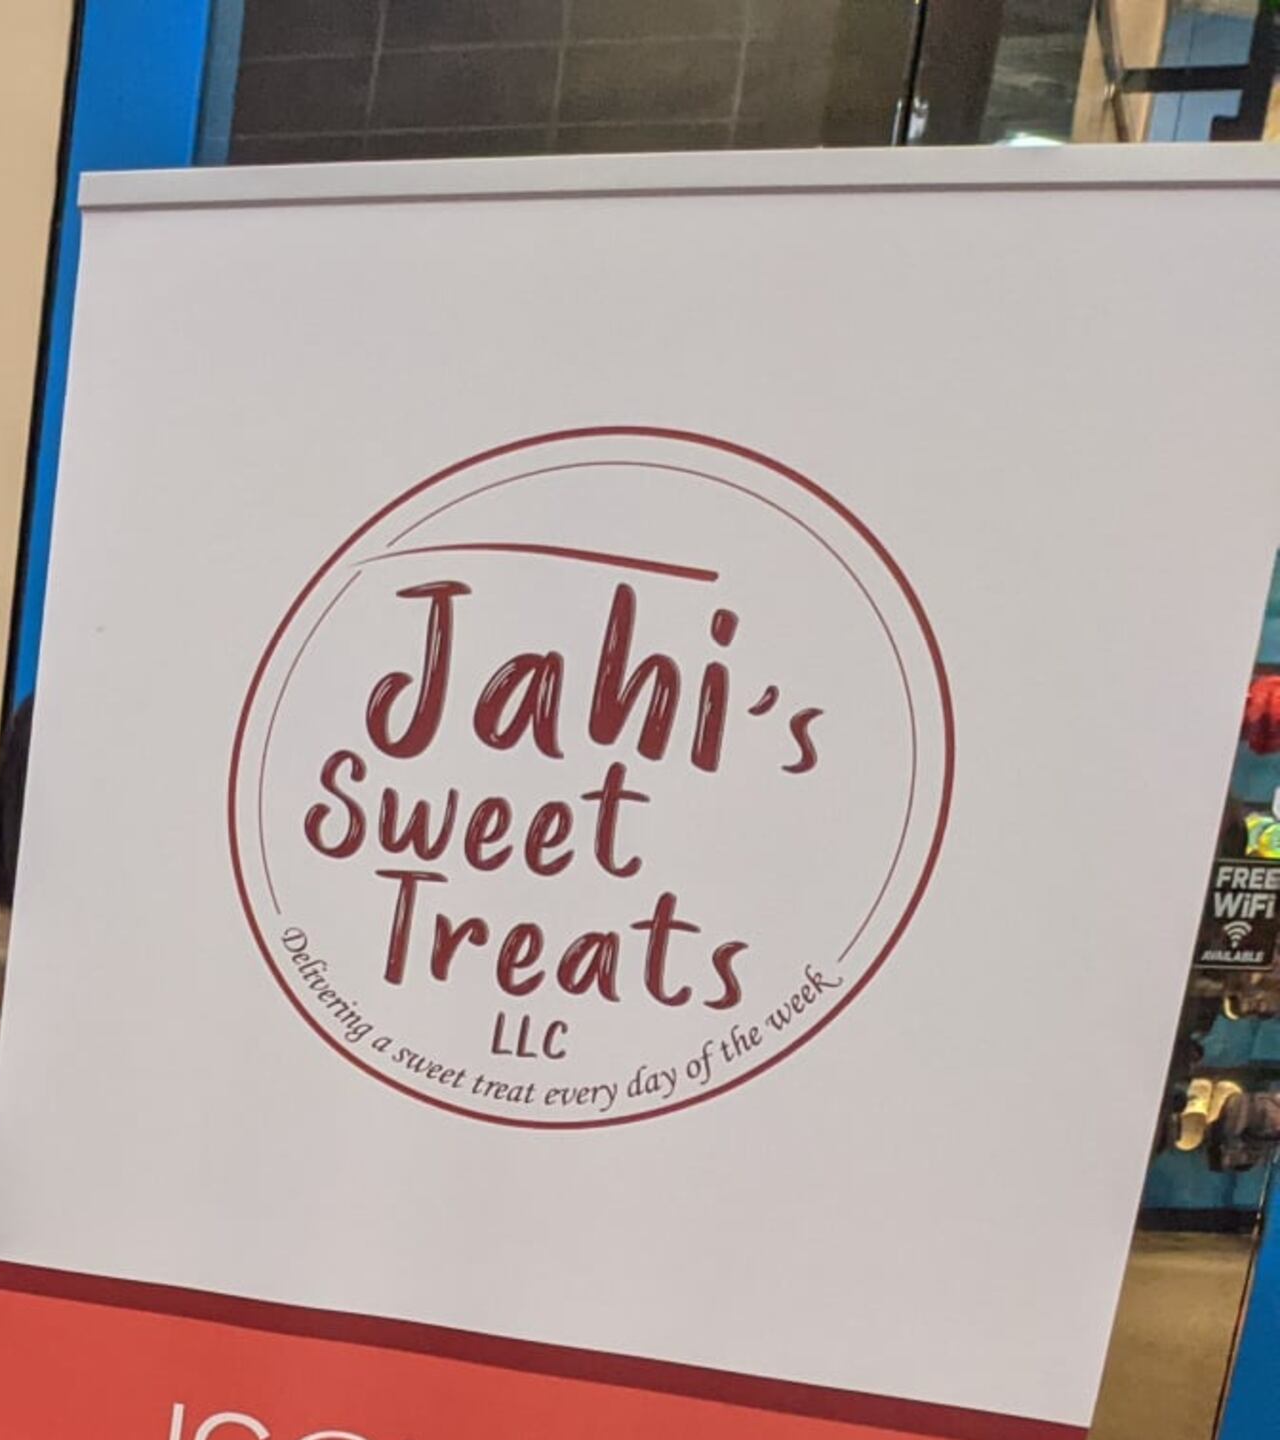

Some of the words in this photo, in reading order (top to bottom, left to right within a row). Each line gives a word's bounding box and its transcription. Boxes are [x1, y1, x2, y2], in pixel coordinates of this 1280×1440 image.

[365, 580, 824, 774] Jahi's
[303, 749, 650, 878] Sweet
[1216, 866, 1280, 890] FREE
[375, 870, 749, 1010] Treats
[1201, 951, 1265, 963] AVAILABLE
[281, 926, 373, 1043] Delivering
[370, 1032, 394, 1053] a
[392, 1043, 465, 1090] sweet
[472, 1073, 536, 1106] treat
[545, 1078, 617, 1112] every
[626, 1063, 679, 1102] day
[685, 1040, 719, 1084] of
[720, 1017, 763, 1064] the
[768, 966, 842, 1034] week
[490, 1011, 569, 1060] LLC
